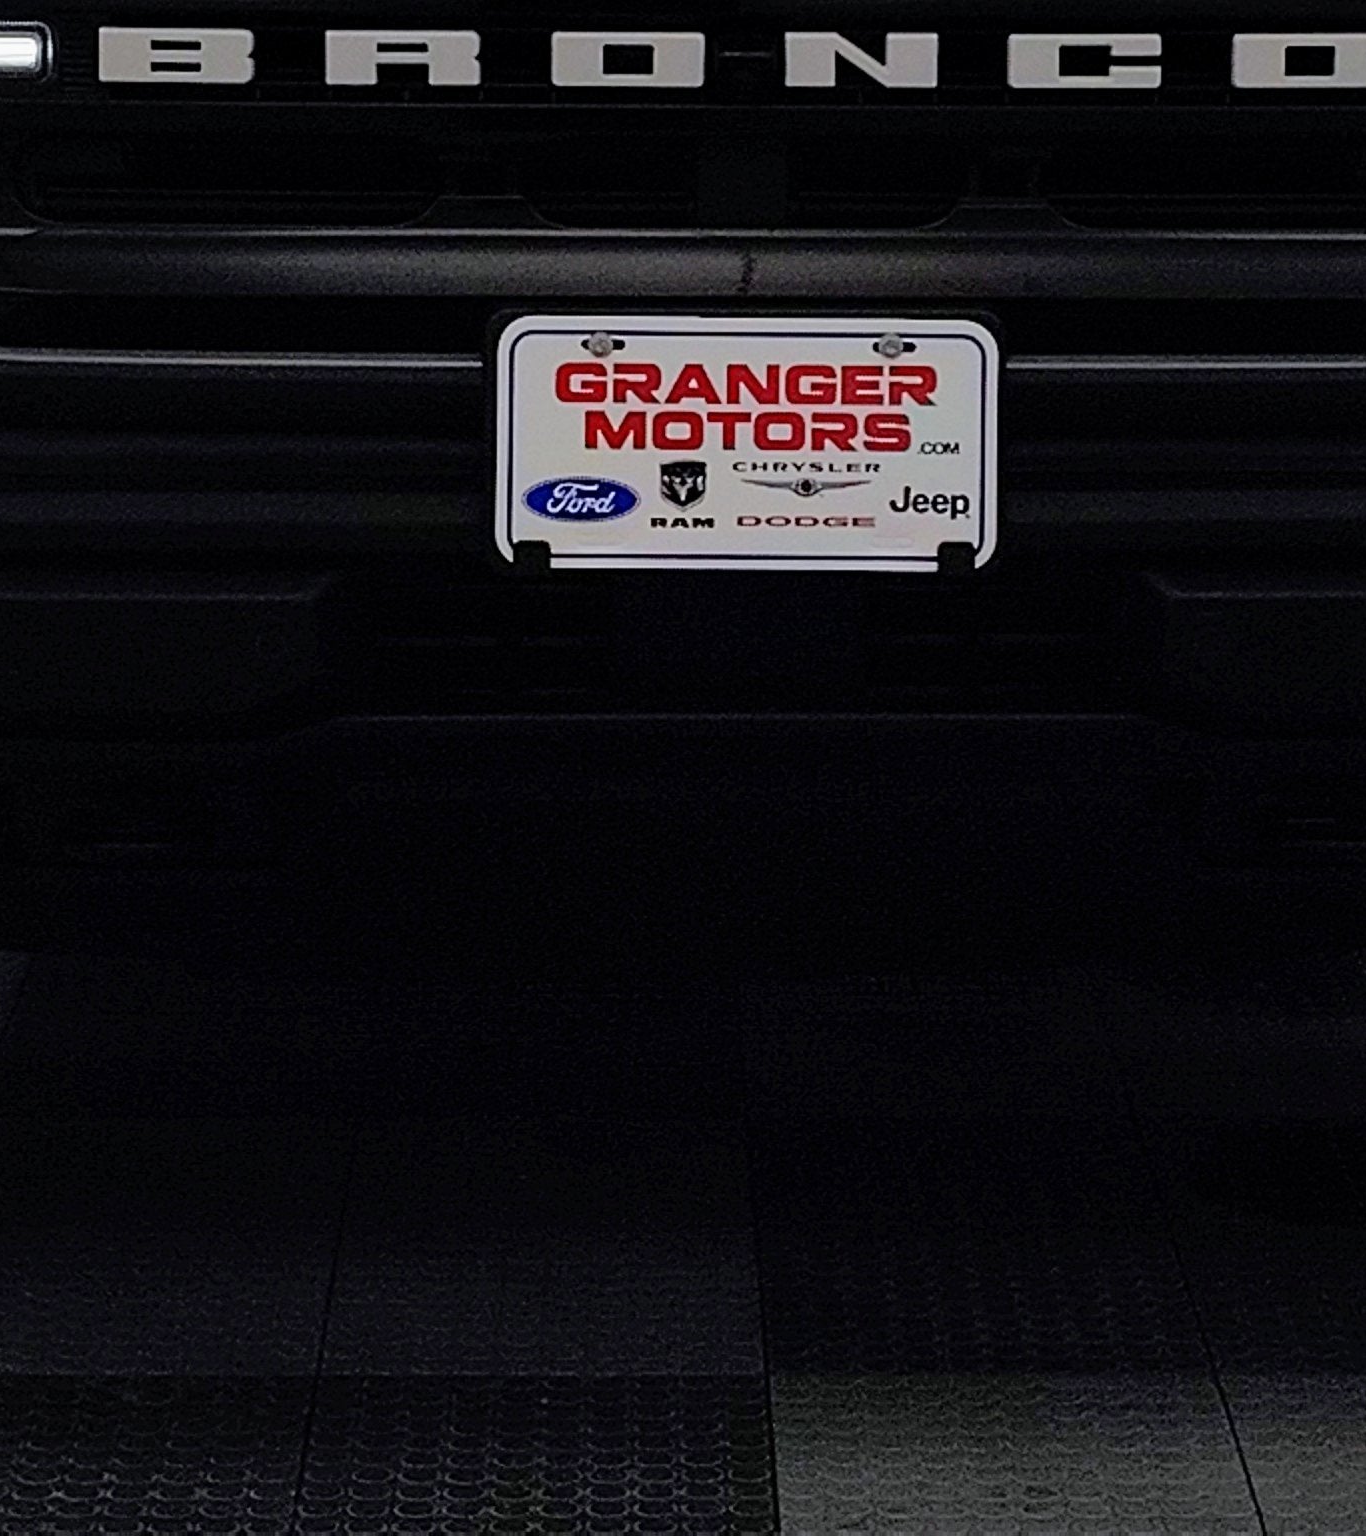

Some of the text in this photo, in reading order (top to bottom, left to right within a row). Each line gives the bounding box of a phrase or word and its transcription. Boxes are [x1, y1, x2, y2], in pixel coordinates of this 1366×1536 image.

[555, 362, 937, 406] GRANGER
[584, 410, 911, 452] MOTORS
[732, 461, 881, 474] CHRYSLER
[546, 482, 616, 514] Ford
[890, 486, 970, 519] Jeep
[650, 517, 715, 529] RAM
[737, 515, 877, 528] DODGE
